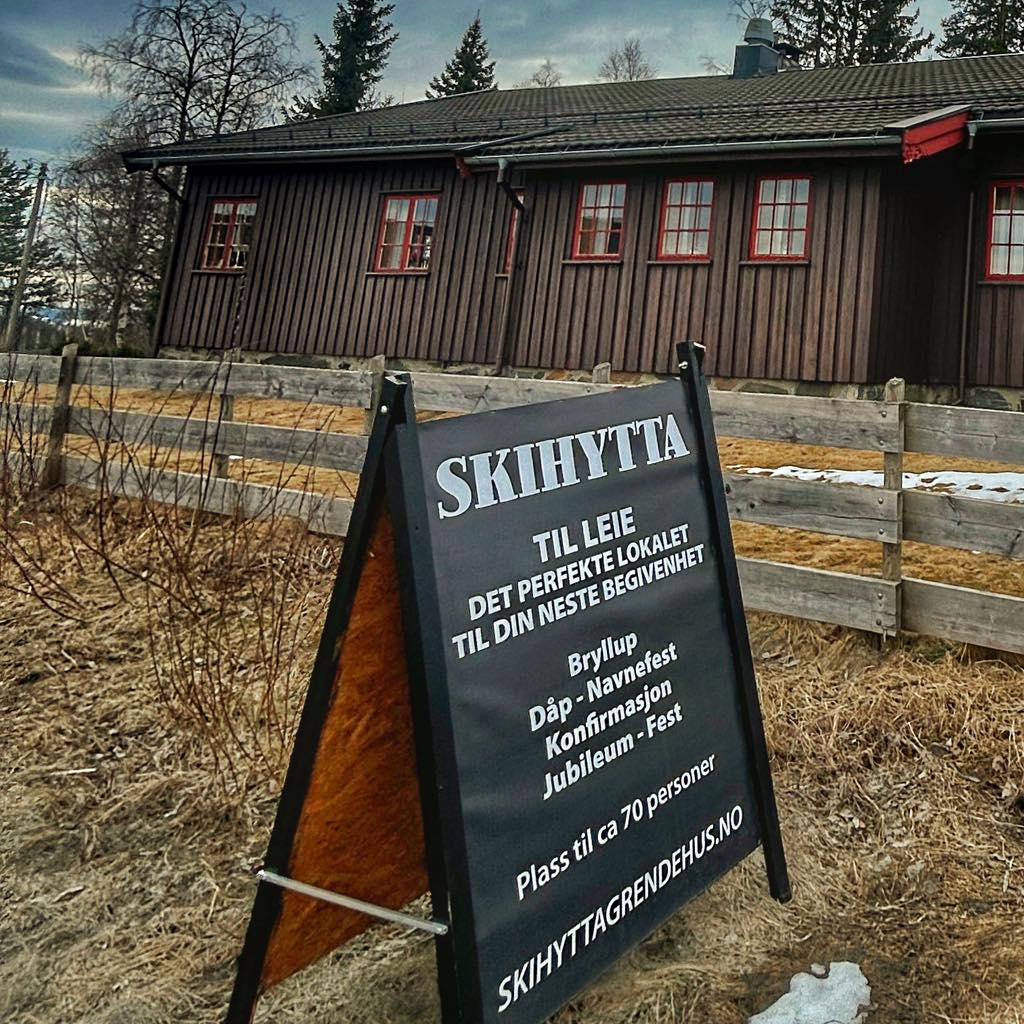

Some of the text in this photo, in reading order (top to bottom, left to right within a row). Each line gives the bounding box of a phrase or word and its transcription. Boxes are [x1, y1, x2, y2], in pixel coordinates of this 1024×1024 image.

[436, 414, 690, 519] SKIHYTTA
[468, 523, 689, 621] DET PERFEKTE LOKALET
[533, 506, 636, 563] TIL LEIE
[452, 544, 704, 660] TIL DIN NESTE BEGIVENHET
[529, 695, 573, 732] Dåp
[587, 642, 678, 703] Navnefest
[567, 632, 638, 677] Bryllup
[543, 733, 635, 800] Jubileum
[646, 703, 684, 739] Fest
[545, 679, 672, 761] Konfirmasjon
[516, 753, 715, 901] Plass til ca 70 personer
[498, 804, 743, 1013] SKIHYTTAGRENDEHUS.NO
